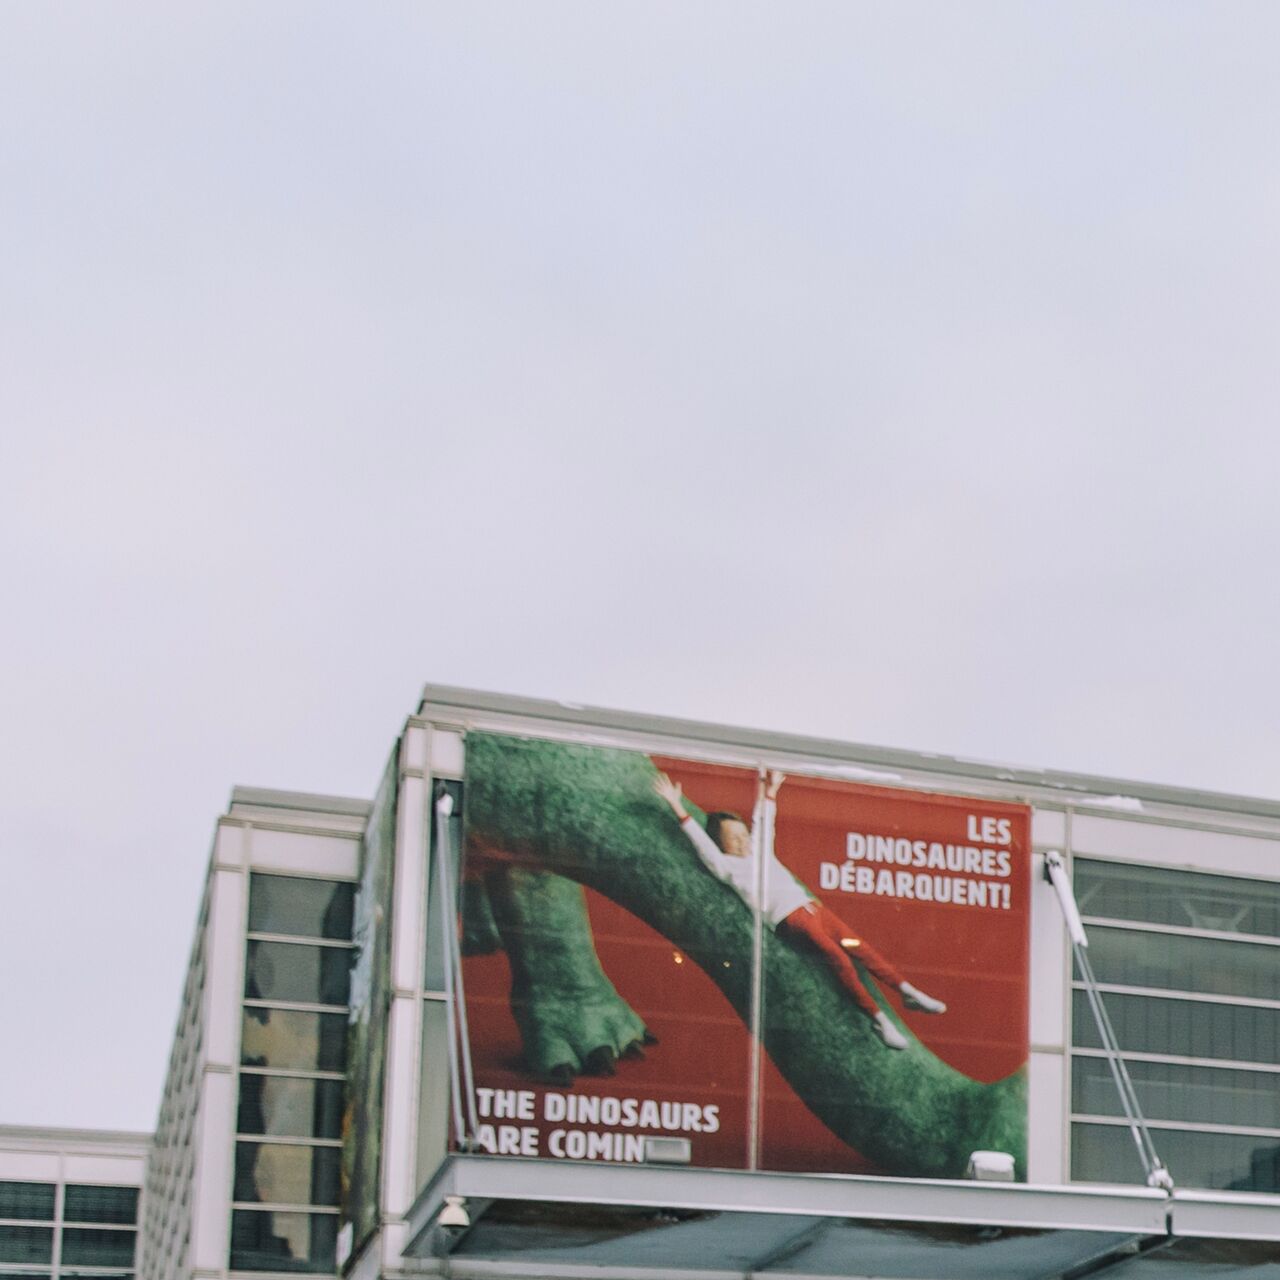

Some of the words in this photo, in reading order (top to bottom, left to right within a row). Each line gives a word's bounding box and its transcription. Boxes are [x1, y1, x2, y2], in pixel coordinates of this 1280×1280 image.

[967, 815, 1011, 846] LES
[847, 832, 1011, 877] DINOSAURES
[819, 861, 1011, 910] DÉBARQUENT!
[476, 1088, 536, 1120] THE
[544, 1092, 720, 1133] DINOSAURS
[478, 1124, 539, 1156] ARE
[548, 1130, 645, 1162] COMIN
